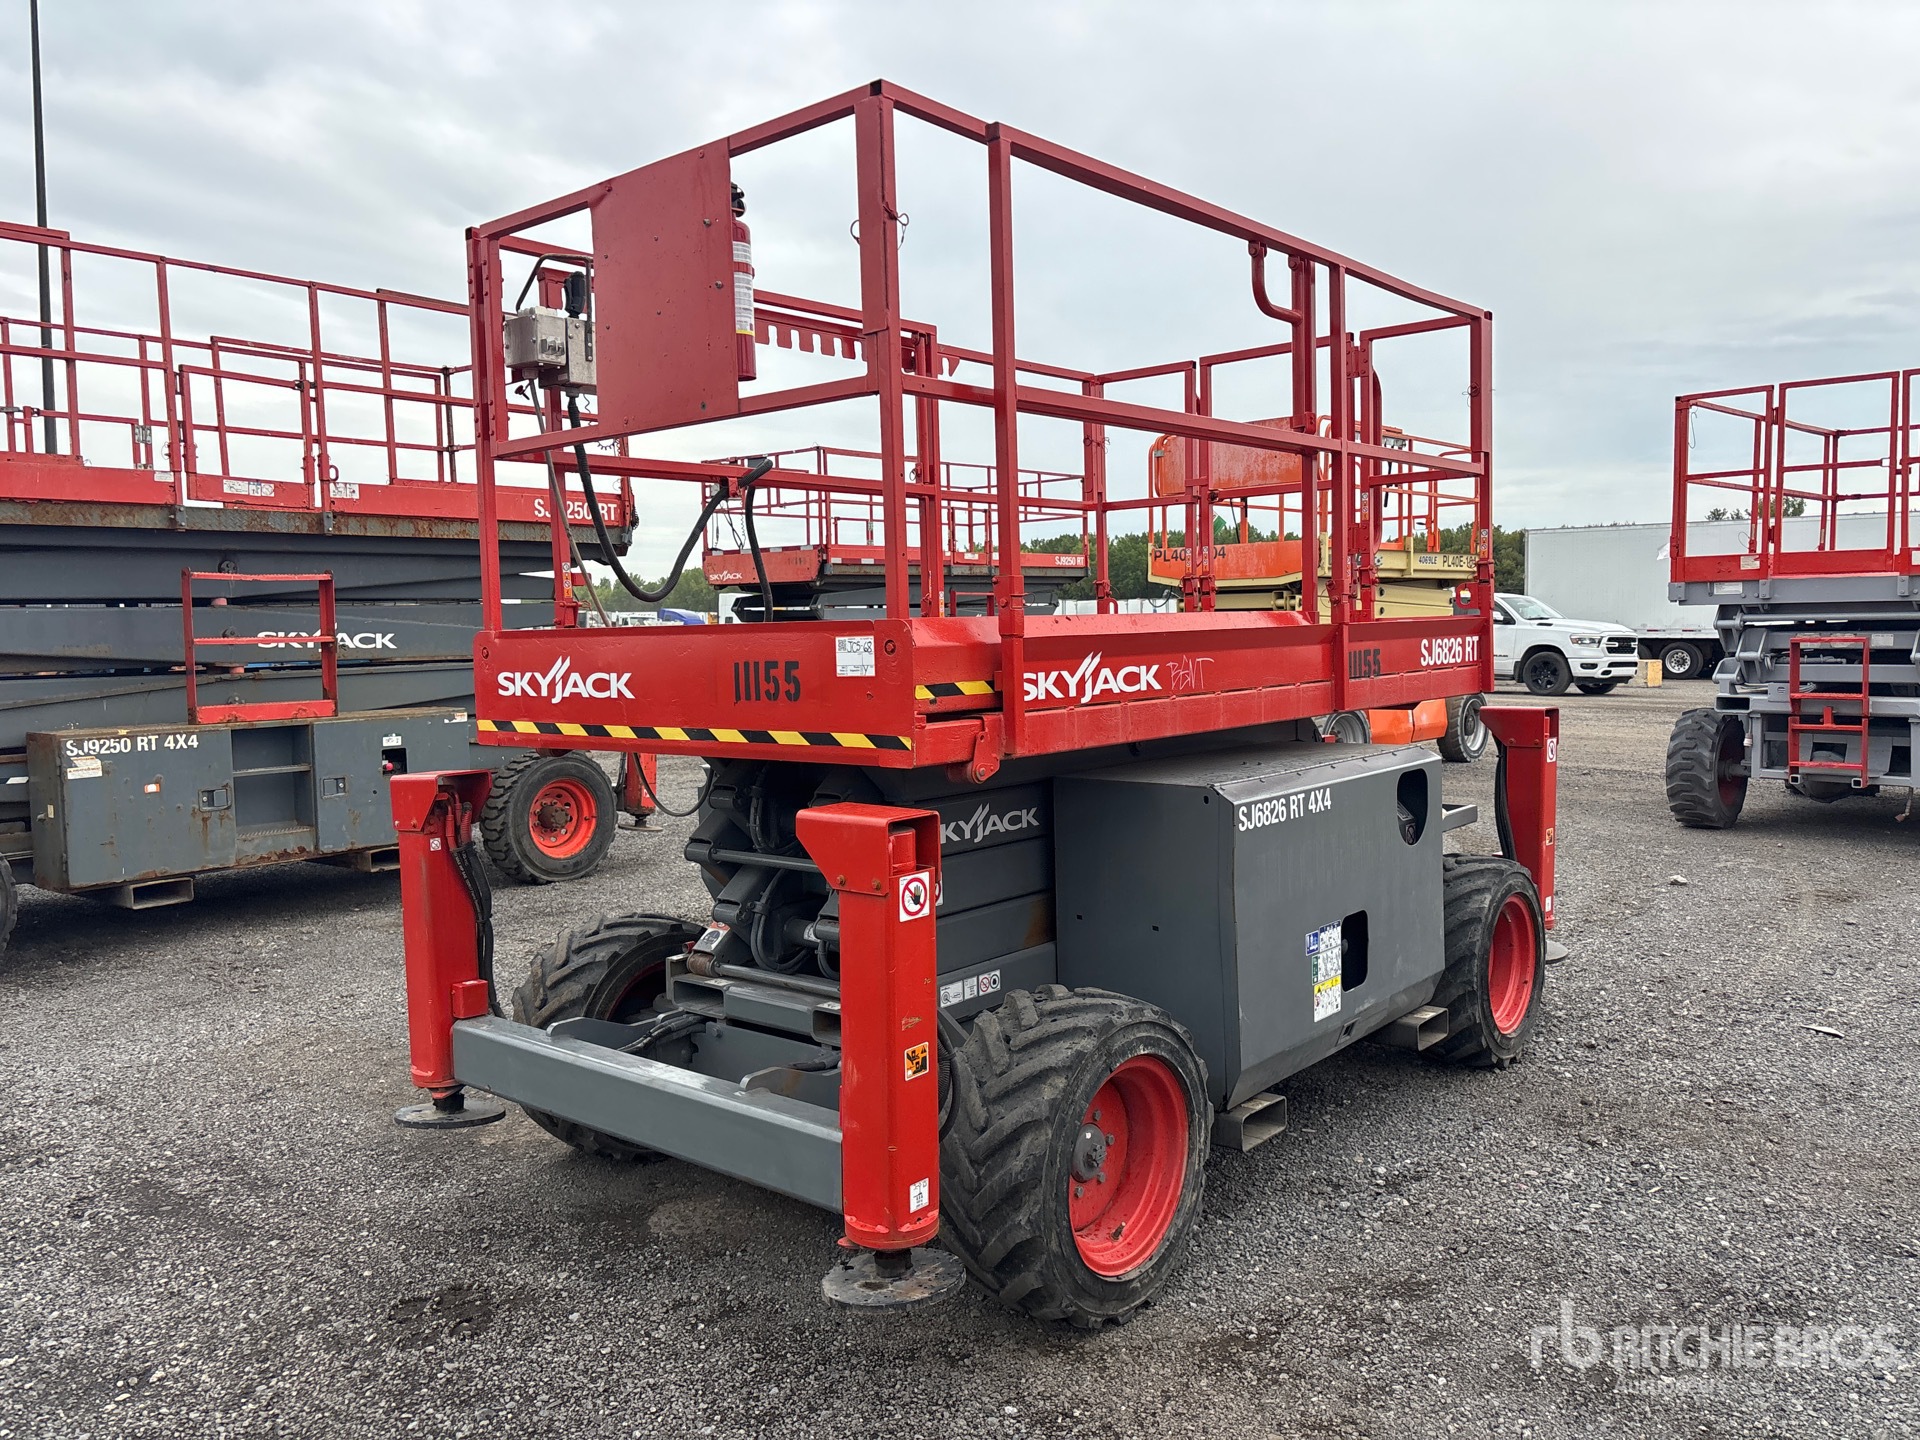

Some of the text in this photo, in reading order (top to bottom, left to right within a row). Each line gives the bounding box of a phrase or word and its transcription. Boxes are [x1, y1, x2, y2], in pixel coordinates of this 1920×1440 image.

[600, 503, 618, 521] RT
[709, 571, 743, 581] SKYJACK
[1421, 636, 1479, 667] SJ6826 RT
[497, 655, 636, 704] SKYJACK
[733, 661, 801, 706] 11155
[1023, 651, 1163, 704] SKYJACK
[136, 735, 159, 751] RT
[164, 734, 199, 750] 4X4
[940, 802, 1040, 843] KYJACK
[1238, 787, 1332, 832] SJ6826 RT 4X4
